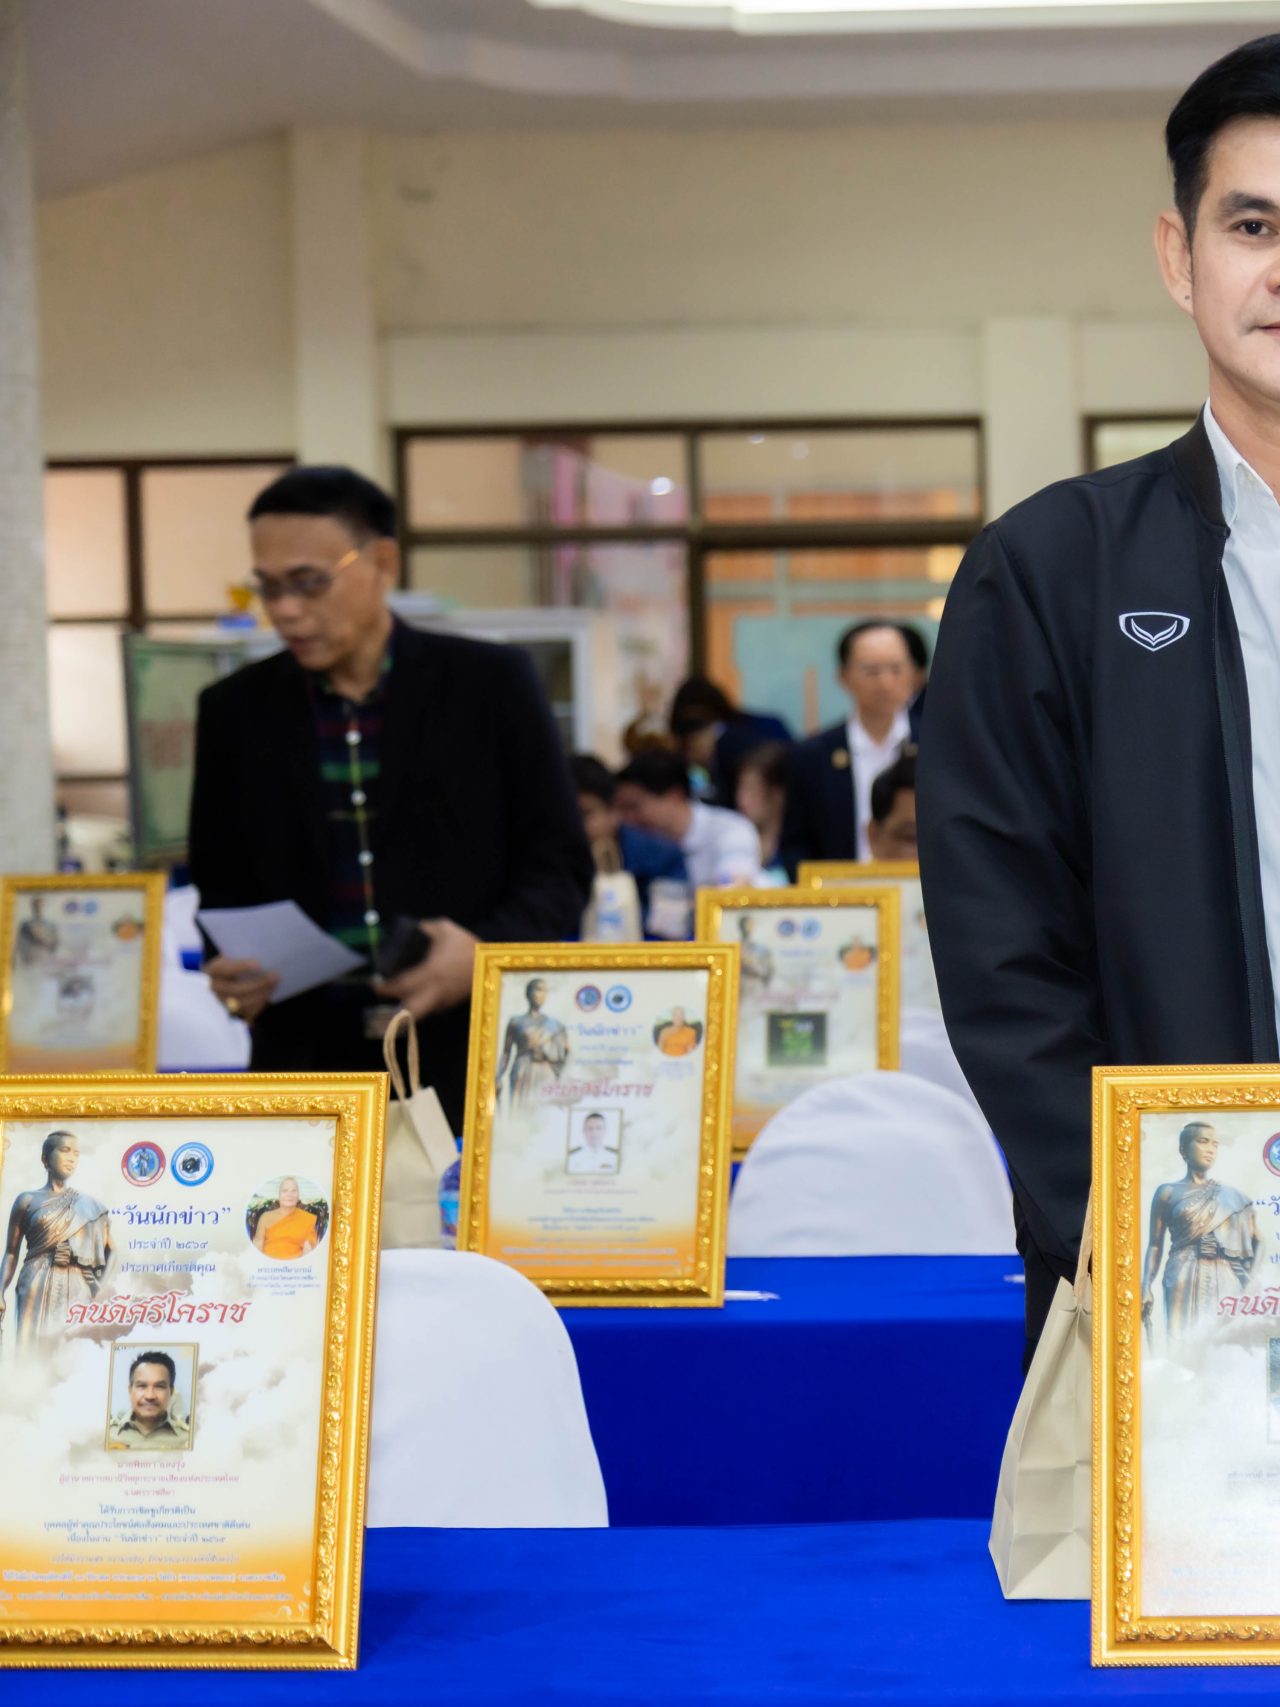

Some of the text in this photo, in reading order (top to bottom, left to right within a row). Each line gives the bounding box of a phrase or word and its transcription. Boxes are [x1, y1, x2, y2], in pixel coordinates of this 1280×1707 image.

[111, 1204, 231, 1225] “วันนักข่าว”
[128, 1237, 171, 1250] ประจำปี
[121, 1260, 216, 1277] ประกาศเกียรติคุณ
[65, 1290, 252, 1324] คนดีศรีโคราช
